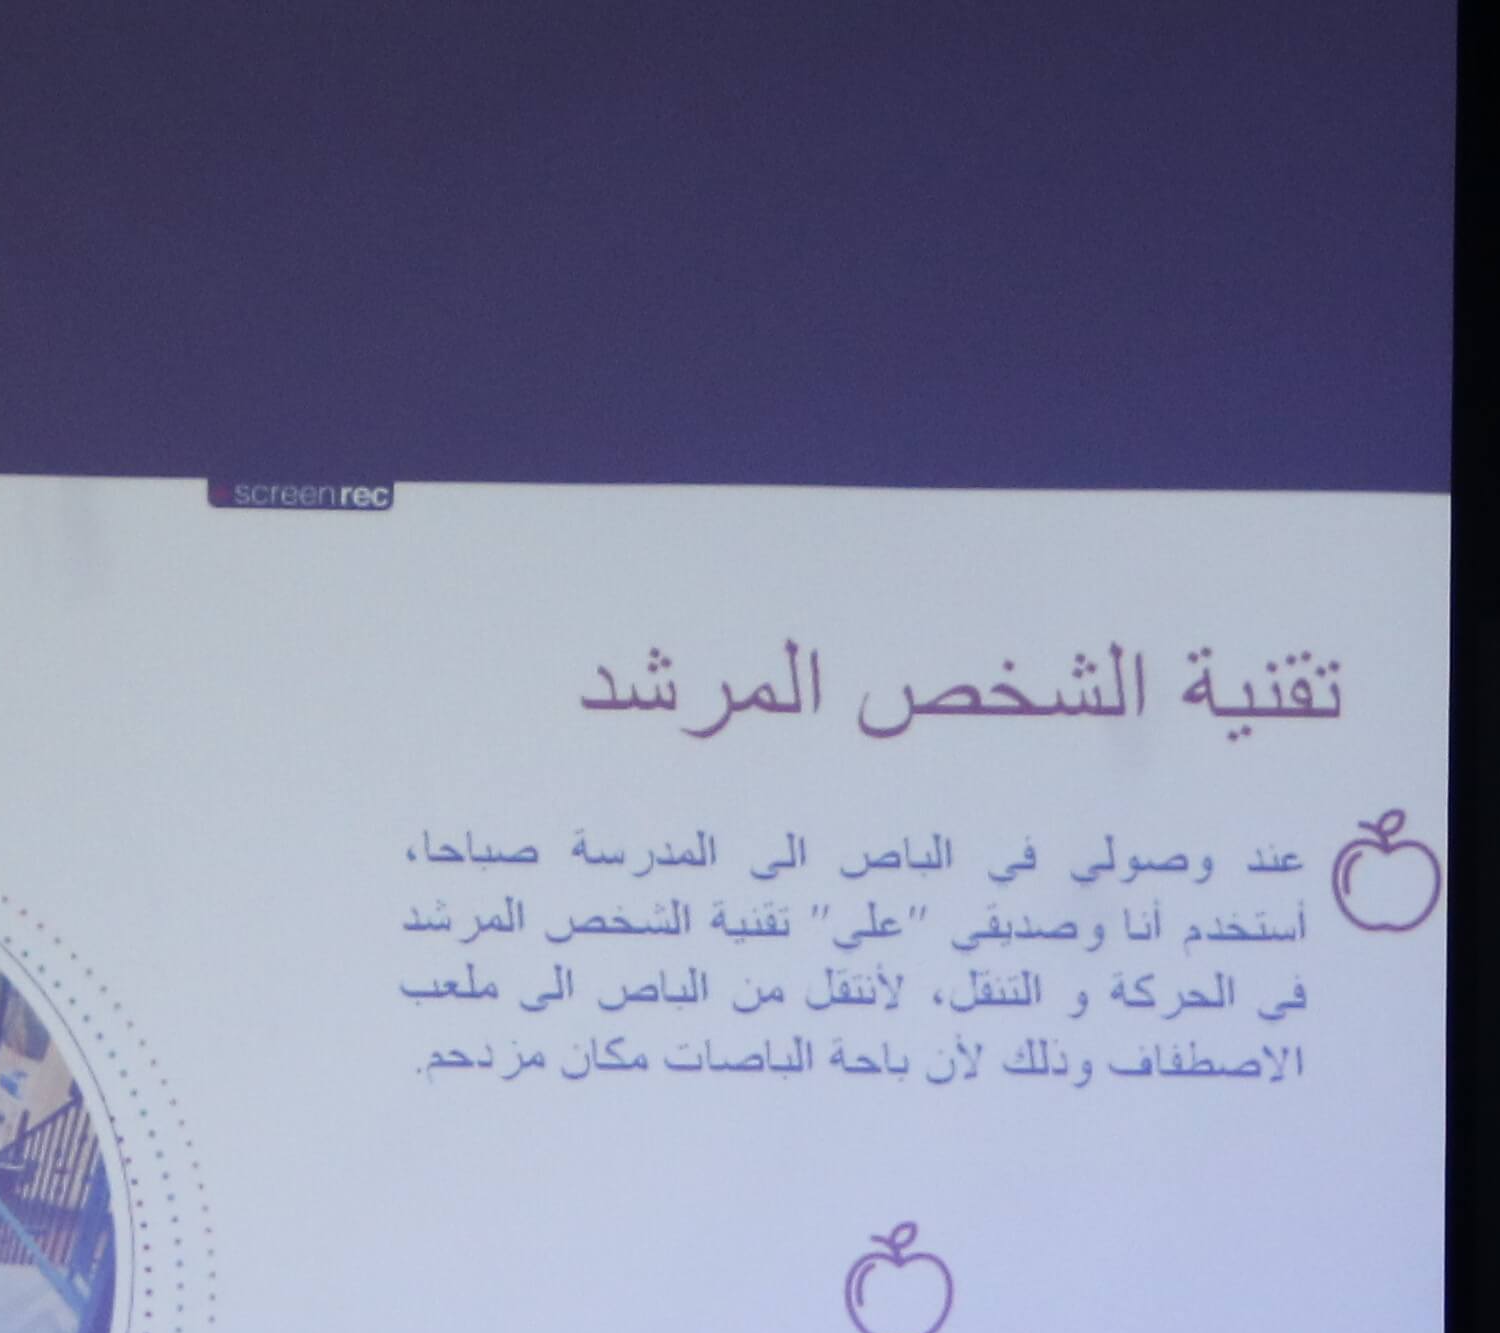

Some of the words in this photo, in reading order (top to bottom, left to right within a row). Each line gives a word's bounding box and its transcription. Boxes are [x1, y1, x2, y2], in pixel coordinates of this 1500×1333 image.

[580, 637, 822, 741] المرشد
[857, 640, 1145, 740] الشخص
[1181, 646, 1341, 743] تقنية
[571, 828, 717, 878] المدرسة
[840, 832, 954, 880] الباص
[1070, 834, 1214, 888] وصولي
[1247, 845, 1304, 874] عند
[402, 896, 525, 945] المرشد
[544, 898, 691, 945] الشخص
[710, 901, 790, 944] تقنية
[1123, 900, 1161, 941] أنا
[1183, 900, 1306, 955] أستخدم
[398, 962, 499, 1006] ملعب
[598, 966, 709, 1013] الباص
[732, 979, 786, 1015] من
[1110, 971, 1235, 1020] الحركة
[560, 1036, 649, 1082] مكان
[664, 1035, 813, 1080] الباصات
[829, 1038, 910, 1082] باحة
[1002, 1038, 1093, 1090] وذلك
